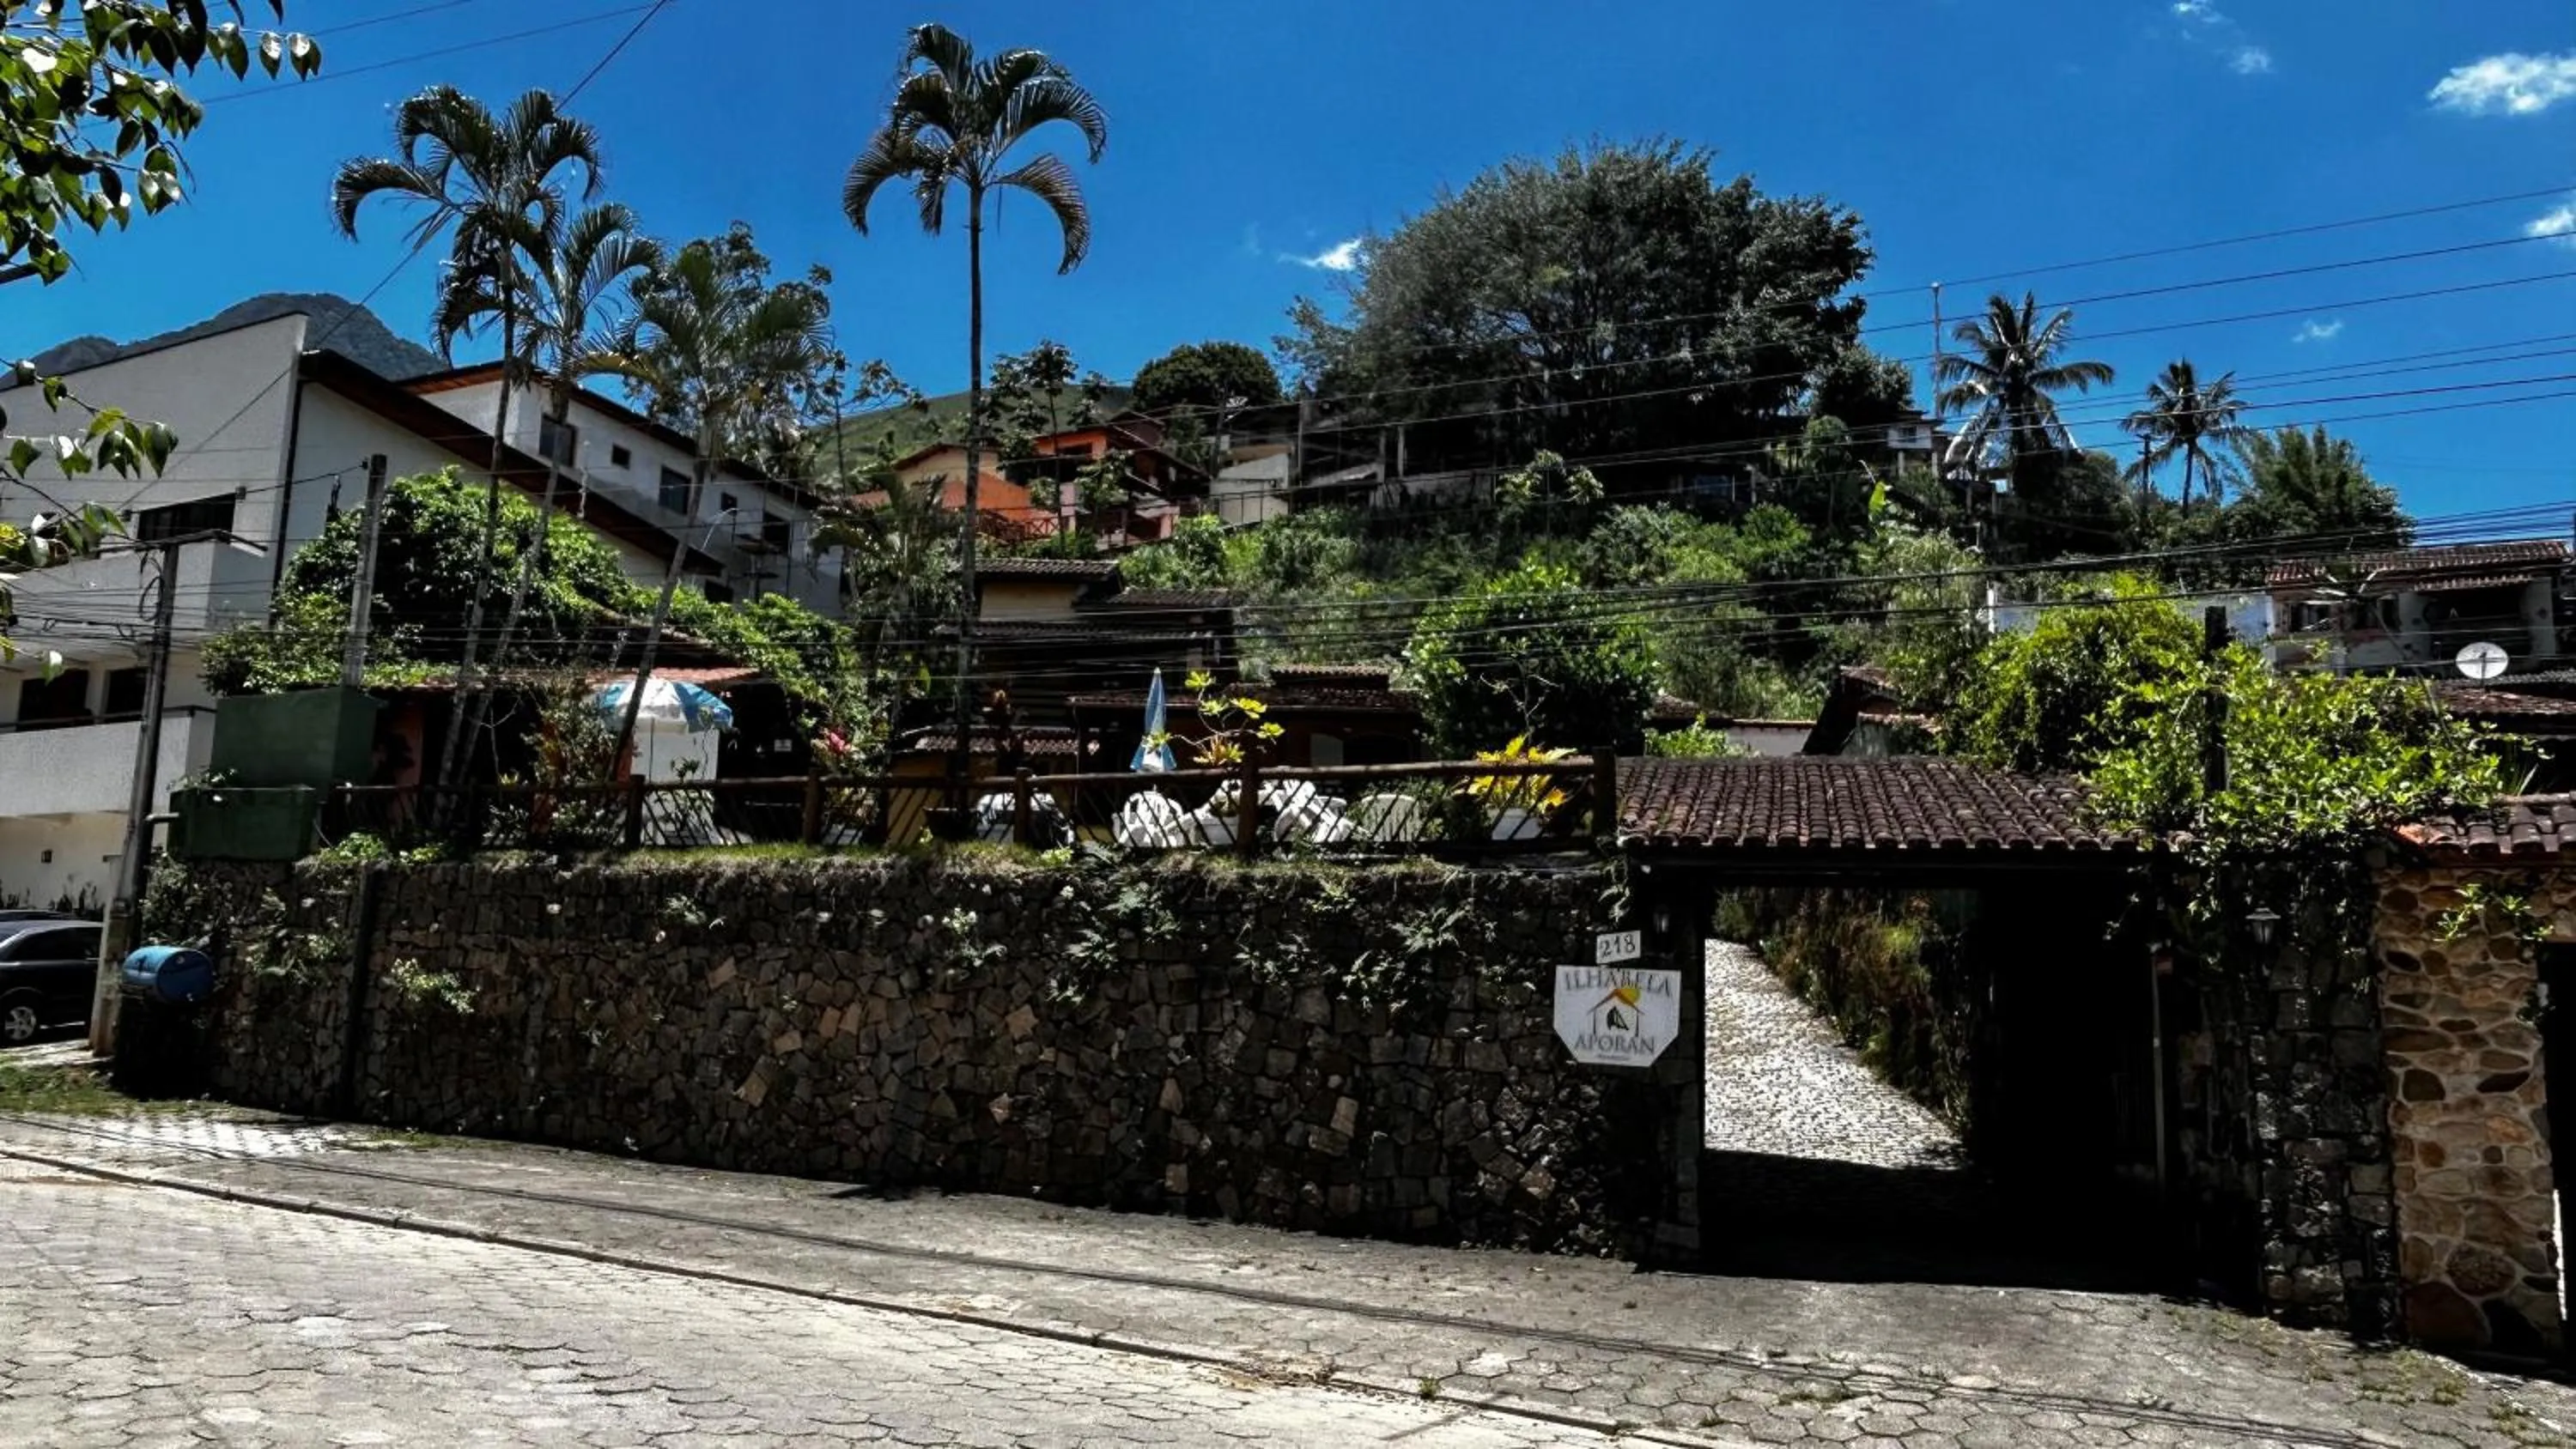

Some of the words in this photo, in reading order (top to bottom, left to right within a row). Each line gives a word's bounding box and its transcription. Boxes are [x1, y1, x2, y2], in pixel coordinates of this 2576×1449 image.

[1599, 934, 1636, 957] 218
[1564, 968, 1672, 997] ILHABELA
[1574, 1034, 1656, 1055] APORAN
